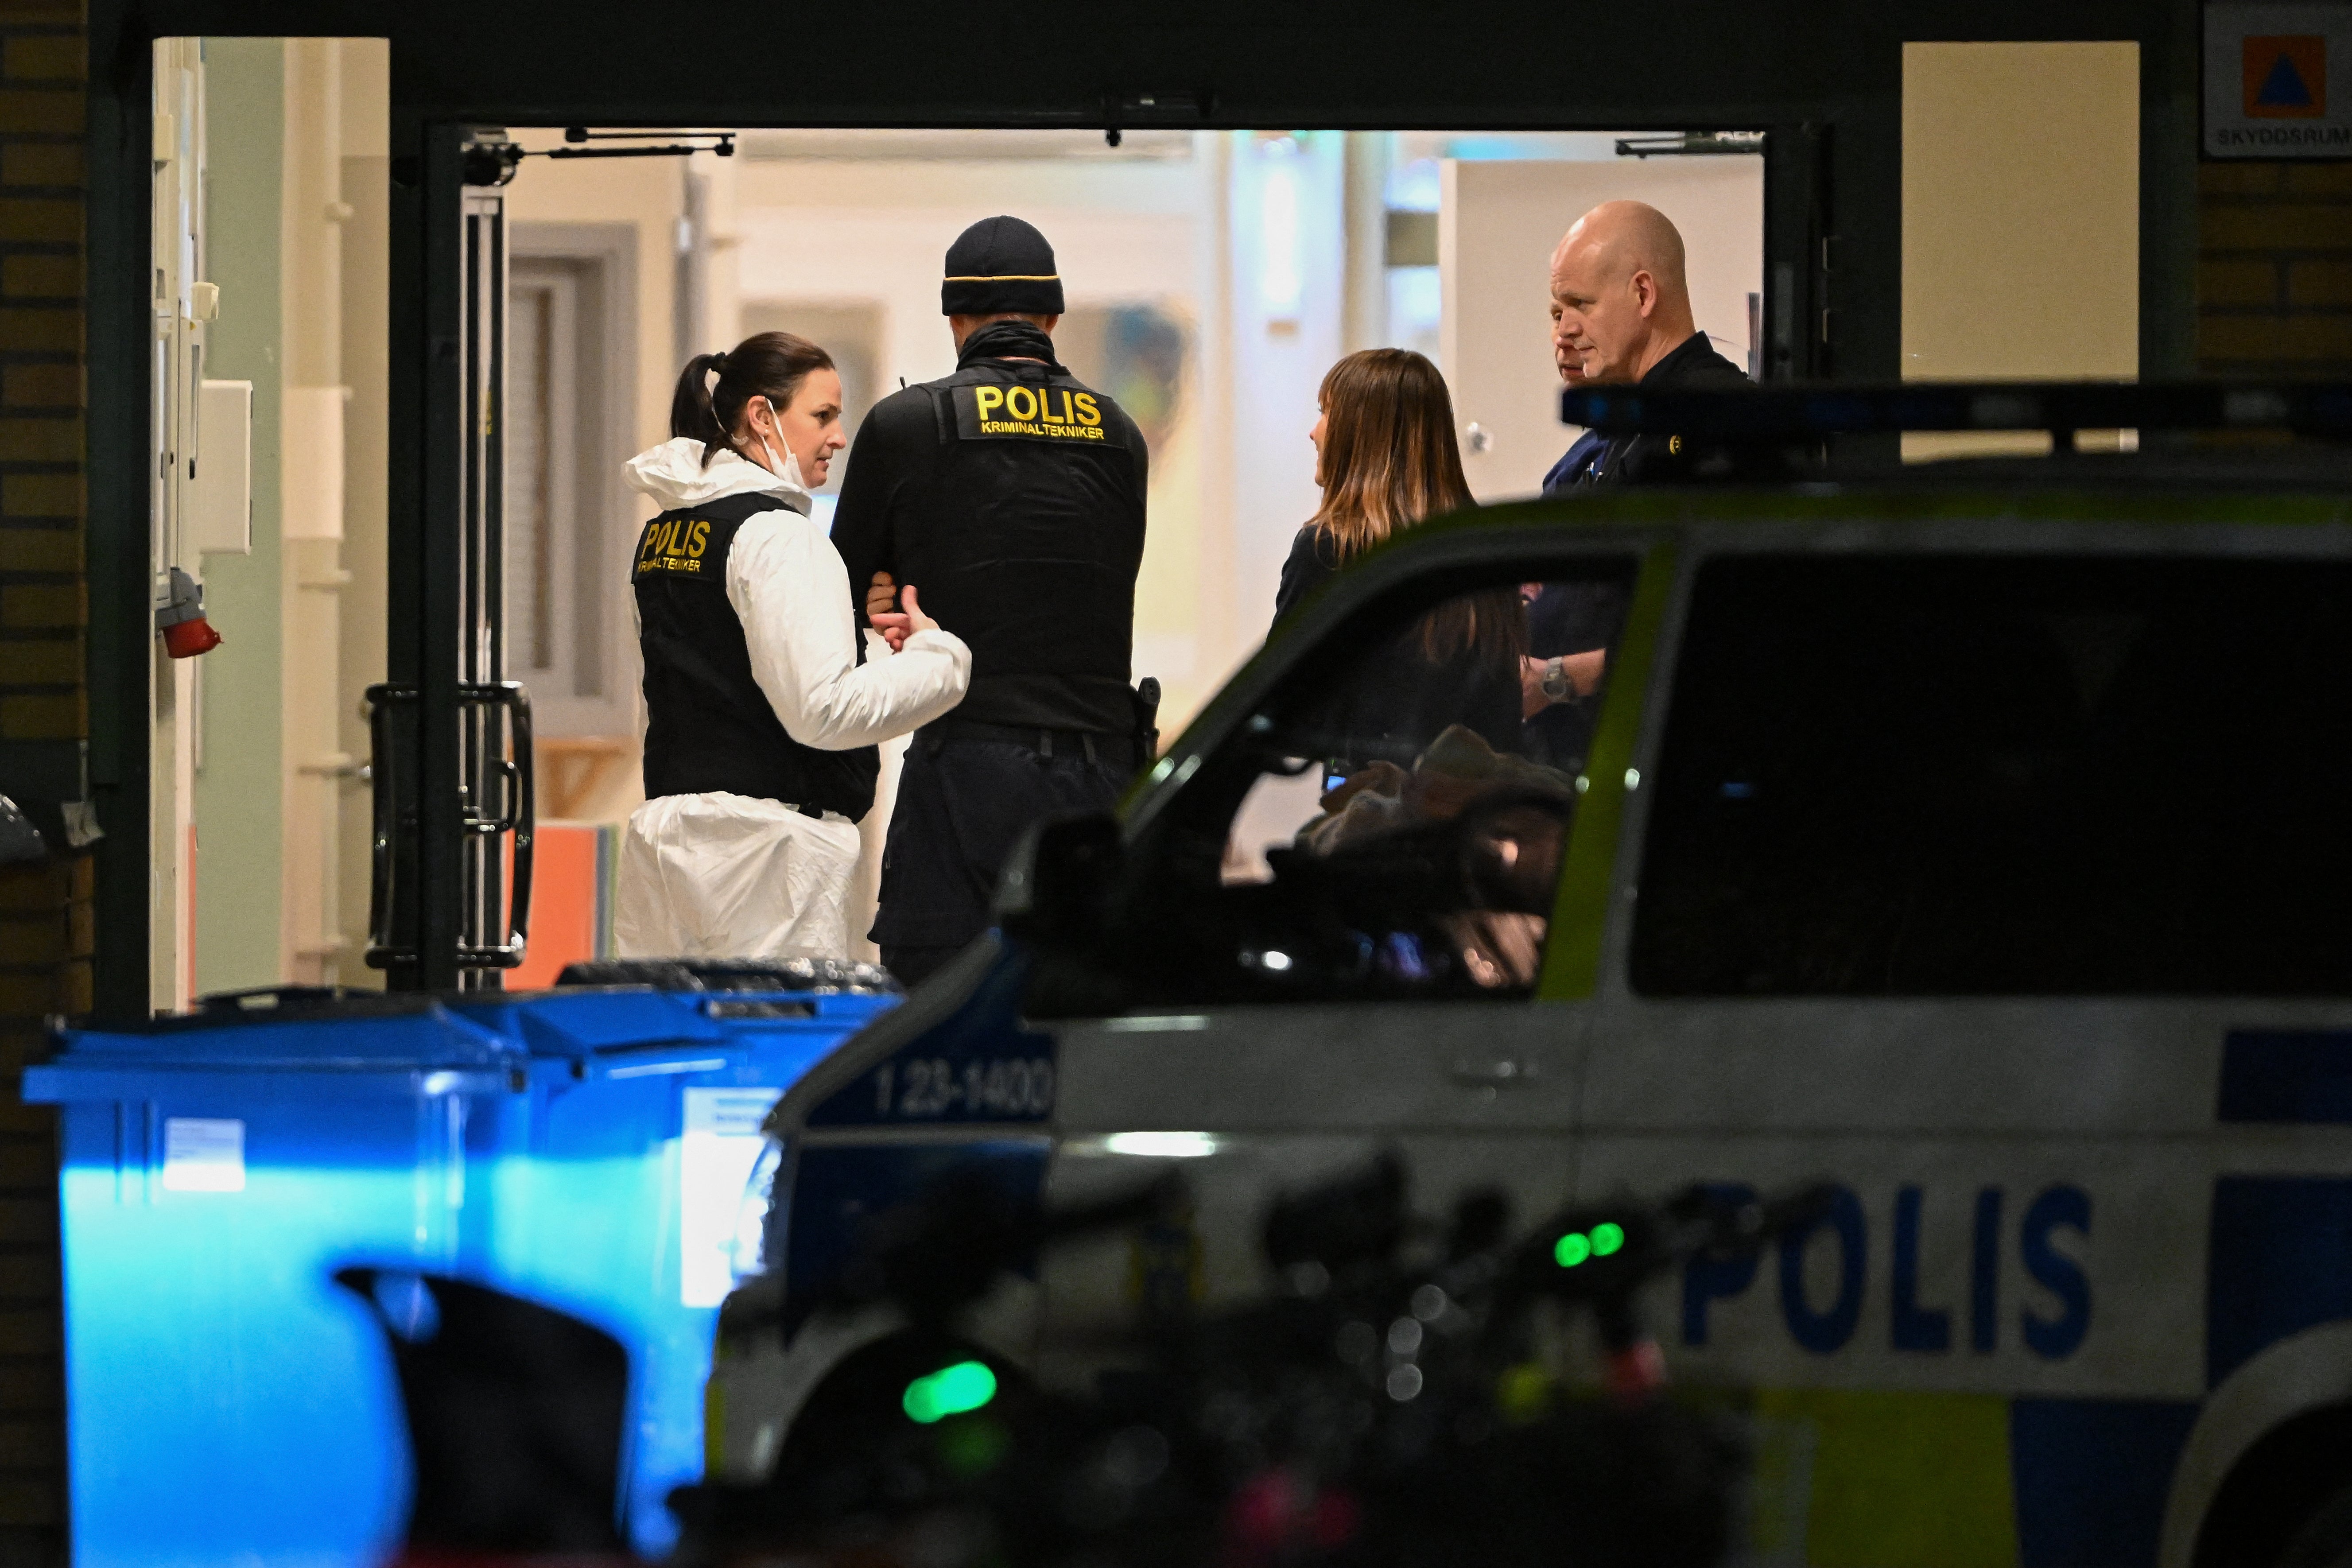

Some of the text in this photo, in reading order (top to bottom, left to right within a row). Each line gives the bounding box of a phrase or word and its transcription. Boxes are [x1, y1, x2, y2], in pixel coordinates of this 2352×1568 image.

[2217, 127, 2350, 144] SKYDDSRUM
[975, 386, 1101, 426] POLIS
[981, 421, 1104, 439] KRIMINALTEKNIKER
[640, 520, 710, 558] POLIS
[638, 557, 701, 572] KRALTEKNIKER
[1683, 1181, 2091, 1360] POLIS
